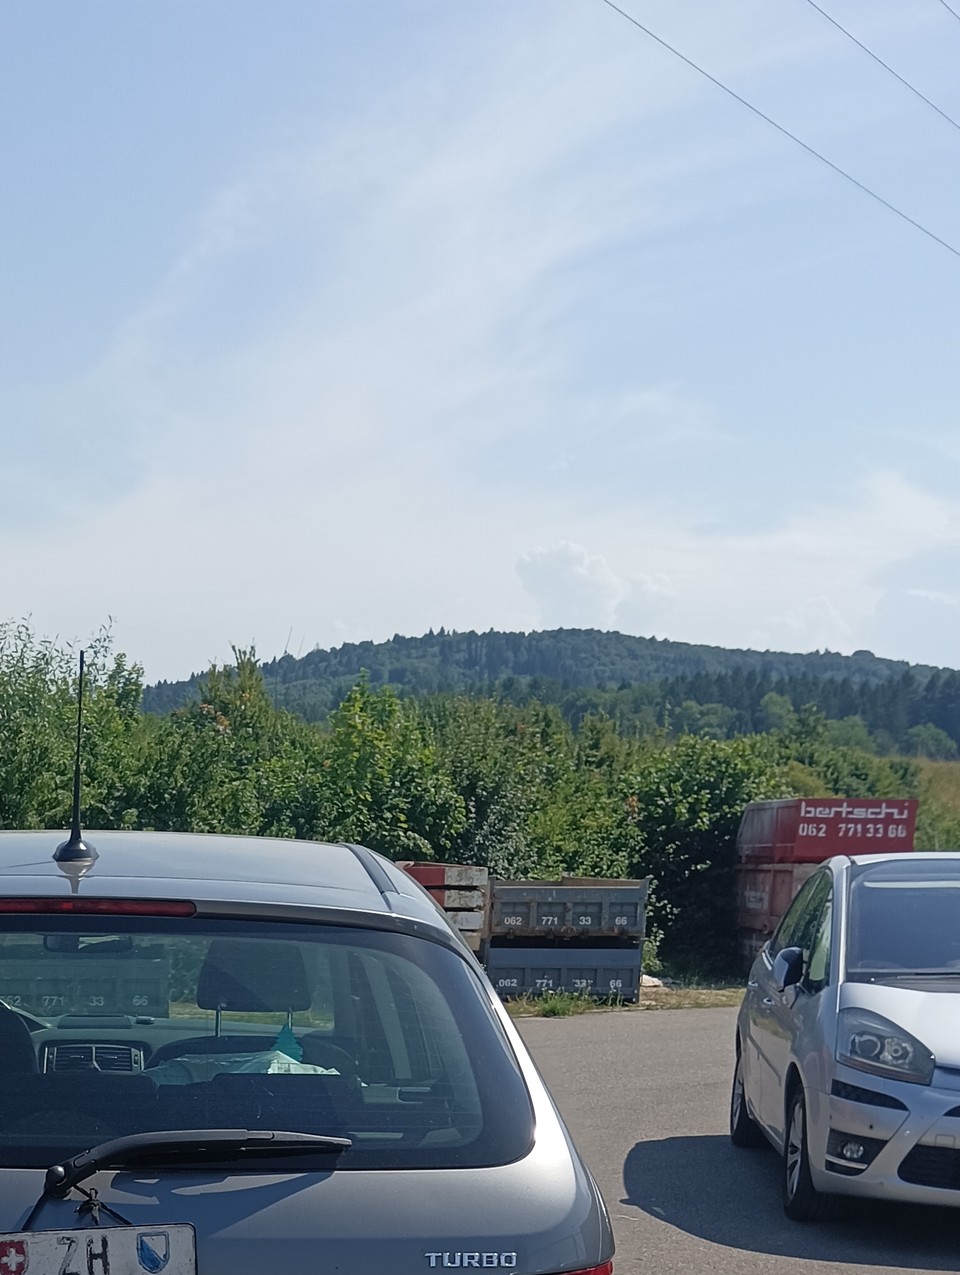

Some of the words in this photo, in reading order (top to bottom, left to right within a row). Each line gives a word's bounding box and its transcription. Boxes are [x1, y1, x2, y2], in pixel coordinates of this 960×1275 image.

[800, 801, 909, 819] bertschi
[799, 823, 827, 837] 062
[837, 823, 862, 838] 771
[865, 823, 884, 838] 33
[887, 824, 907, 838] 66
[504, 916, 523, 926] 062
[541, 916, 559, 926] 771
[579, 916, 592, 926] 33
[615, 916, 628, 926] 66
[498, 979, 518, 987] 062
[535, 979, 554, 988] 771
[609, 980, 622, 988] 66
[43, 996, 65, 1006] 771
[89, 996, 105, 1007] 33
[424, 1252, 518, 1268] TURBO
